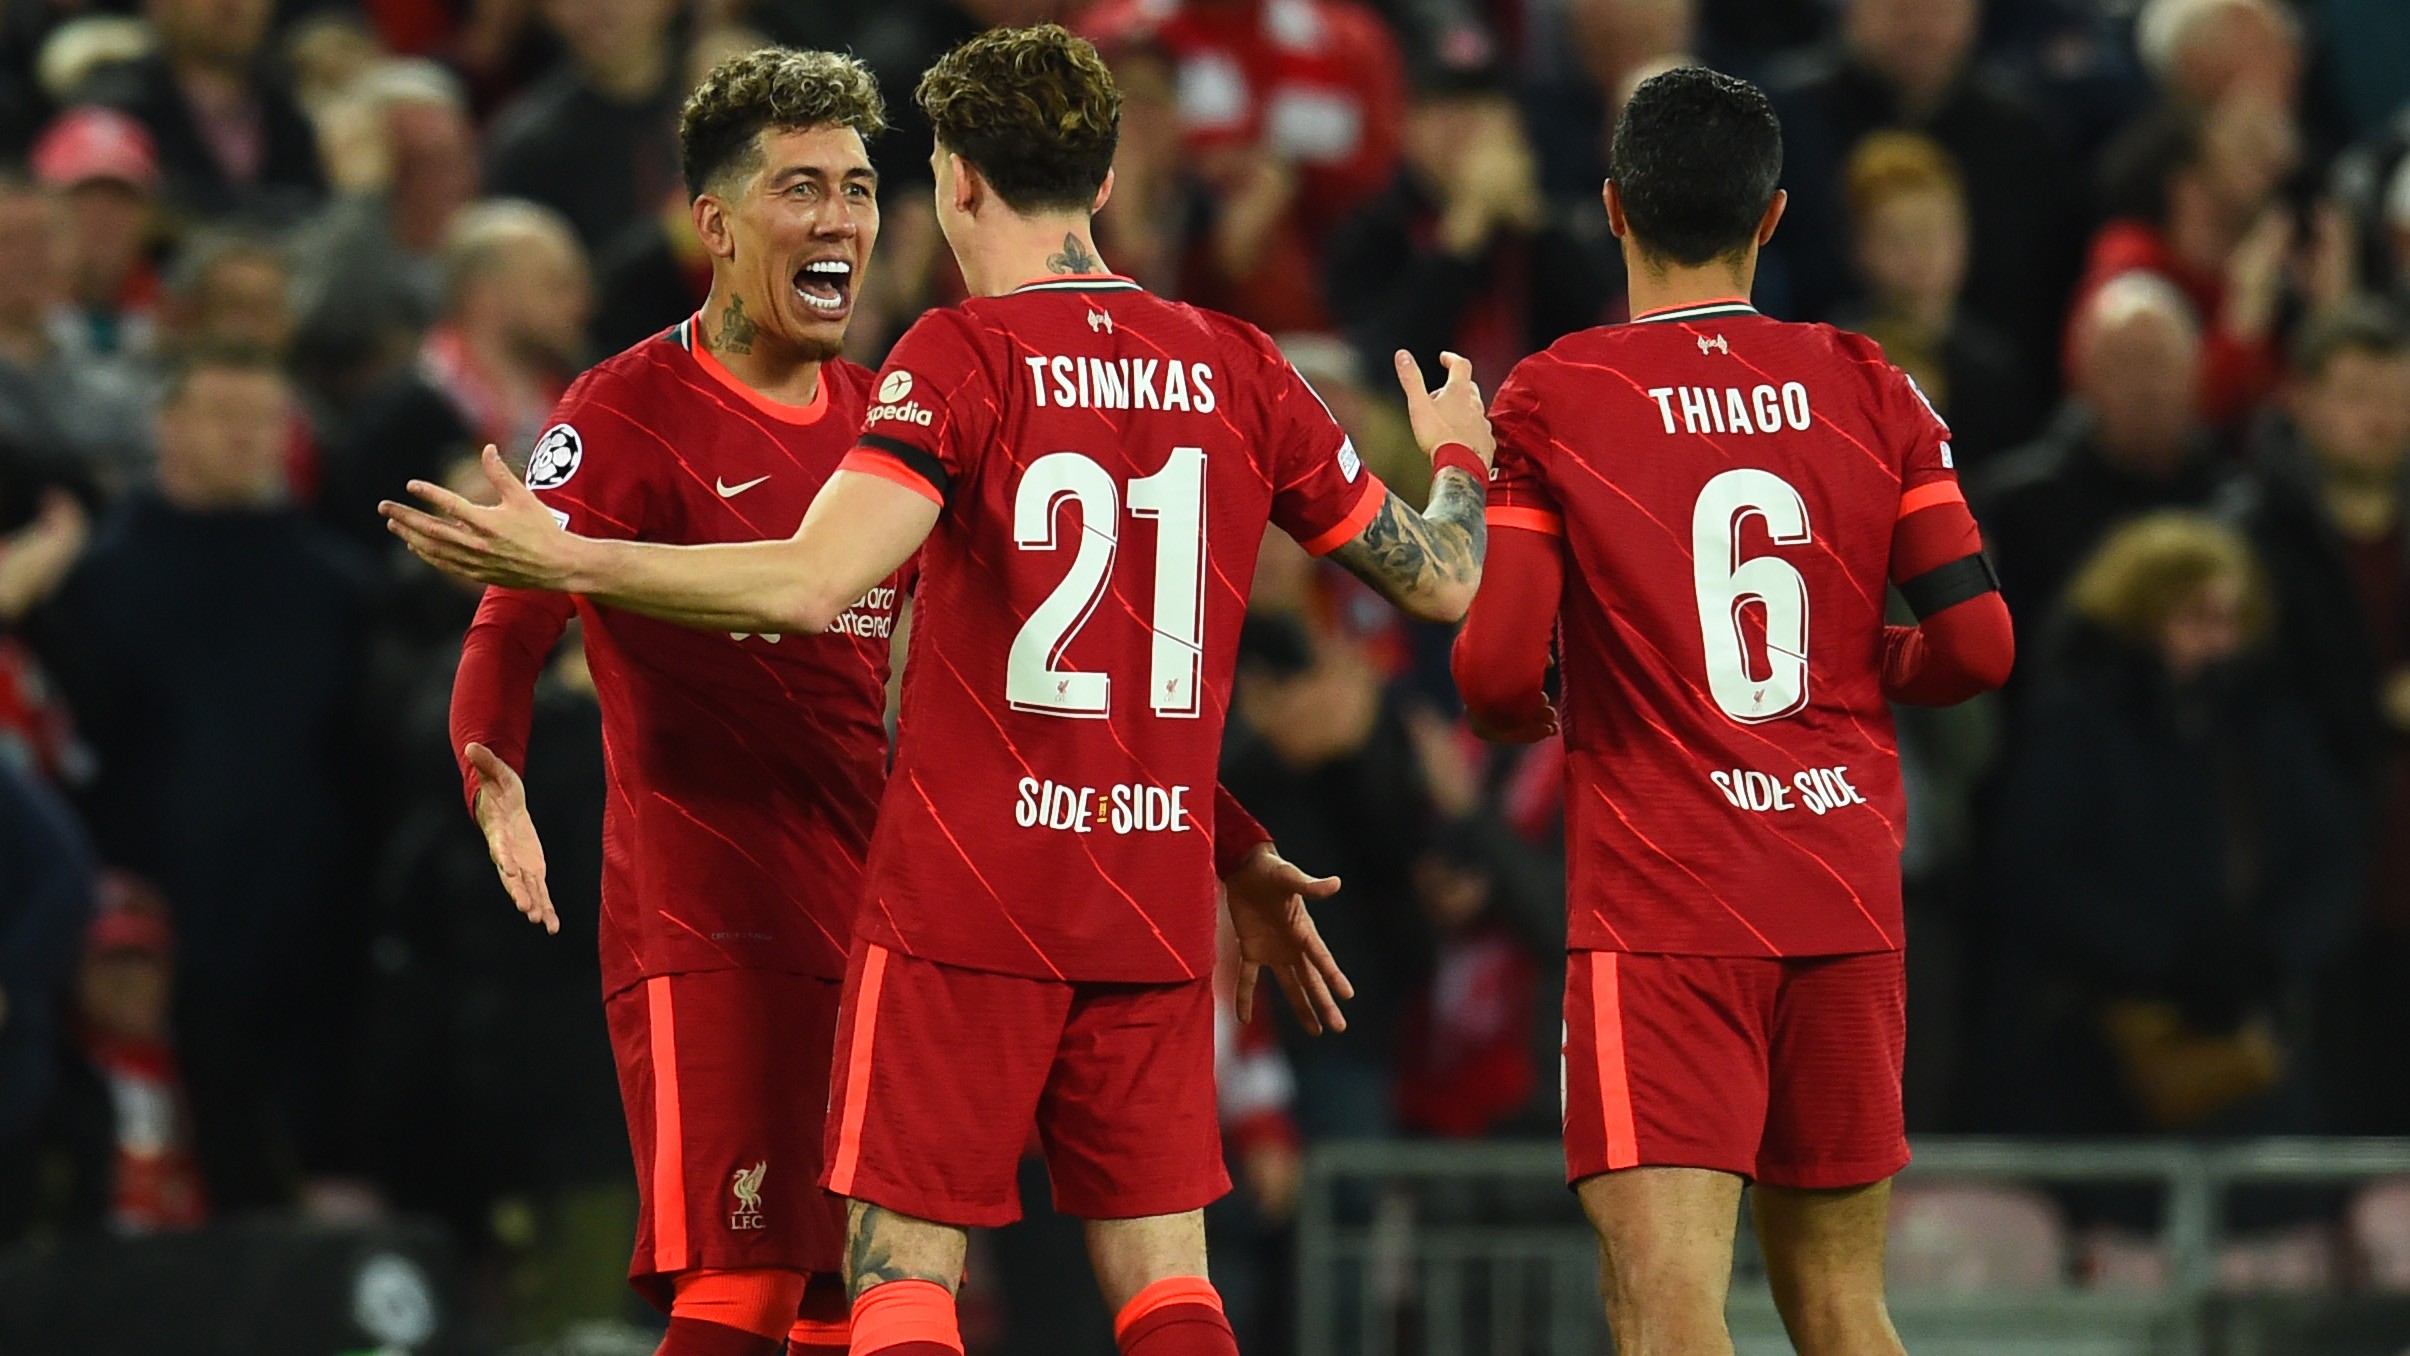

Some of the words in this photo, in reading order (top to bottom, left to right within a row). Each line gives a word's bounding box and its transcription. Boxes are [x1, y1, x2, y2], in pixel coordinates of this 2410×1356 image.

[1024, 355, 1216, 414] TSIMIKAS
[1647, 381, 1811, 435] THIAGO
[1005, 446, 1208, 720] 21
[1692, 467, 1812, 725] 6
[824, 608, 893, 639] artered
[1015, 776, 1096, 833] SIDE
[1111, 783, 1191, 835] SIDE
[1710, 768, 1796, 812] SIDE
[1793, 766, 1867, 816] SIDE
